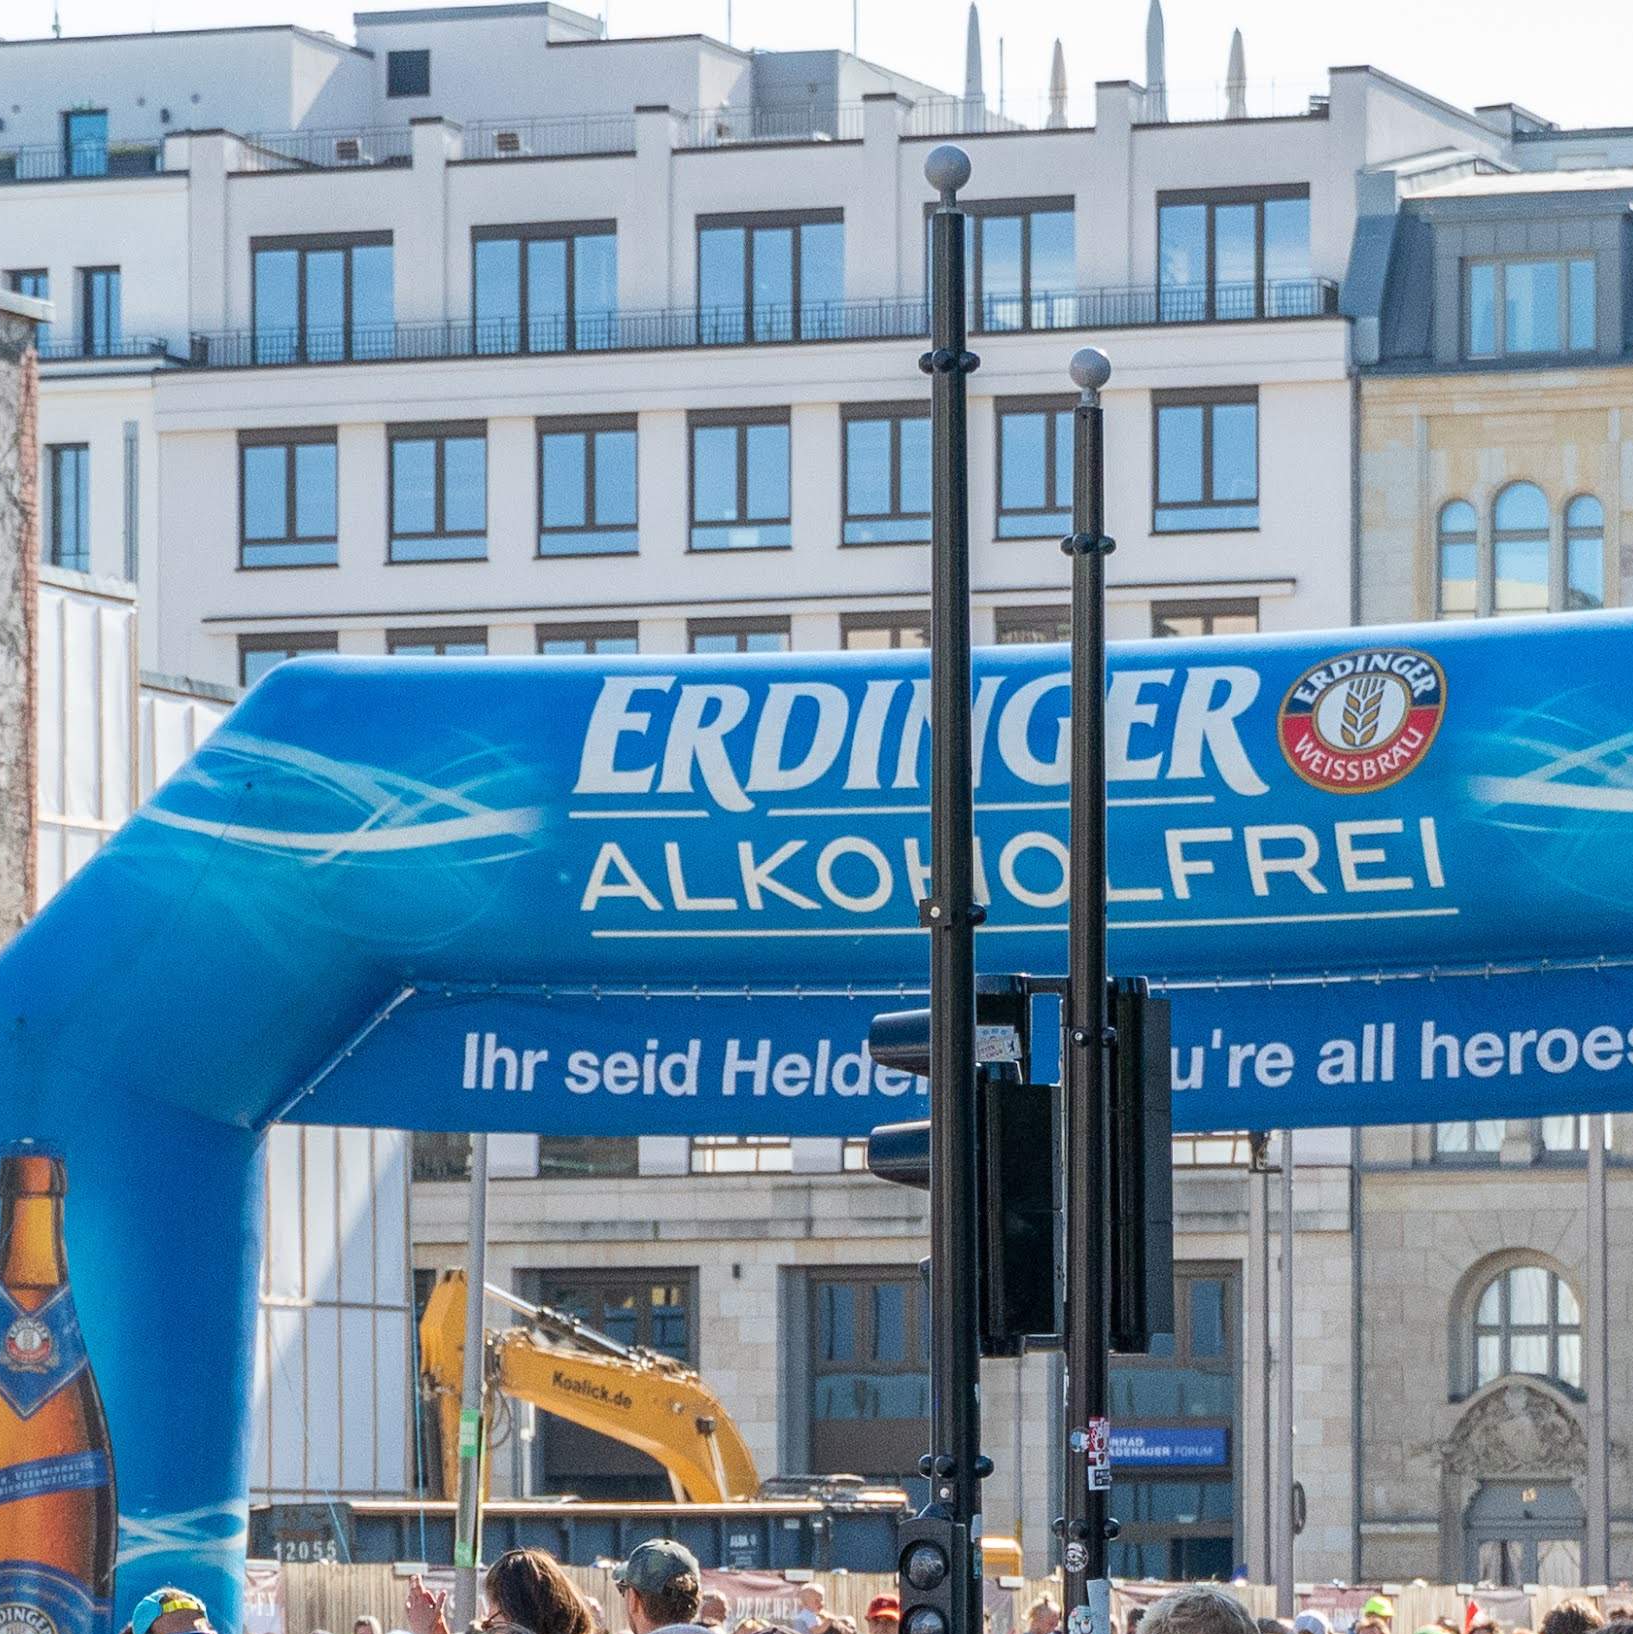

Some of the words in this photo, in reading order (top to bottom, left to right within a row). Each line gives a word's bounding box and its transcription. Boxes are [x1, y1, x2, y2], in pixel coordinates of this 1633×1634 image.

[1293, 654, 1436, 705] ERDINGER
[572, 664, 1270, 812] ERDINGER
[1294, 726, 1425, 782] WEISSBRÄU
[462, 1032, 548, 1091] Ihr
[564, 1039, 701, 1096] seid
[1317, 1022, 1396, 1085] all
